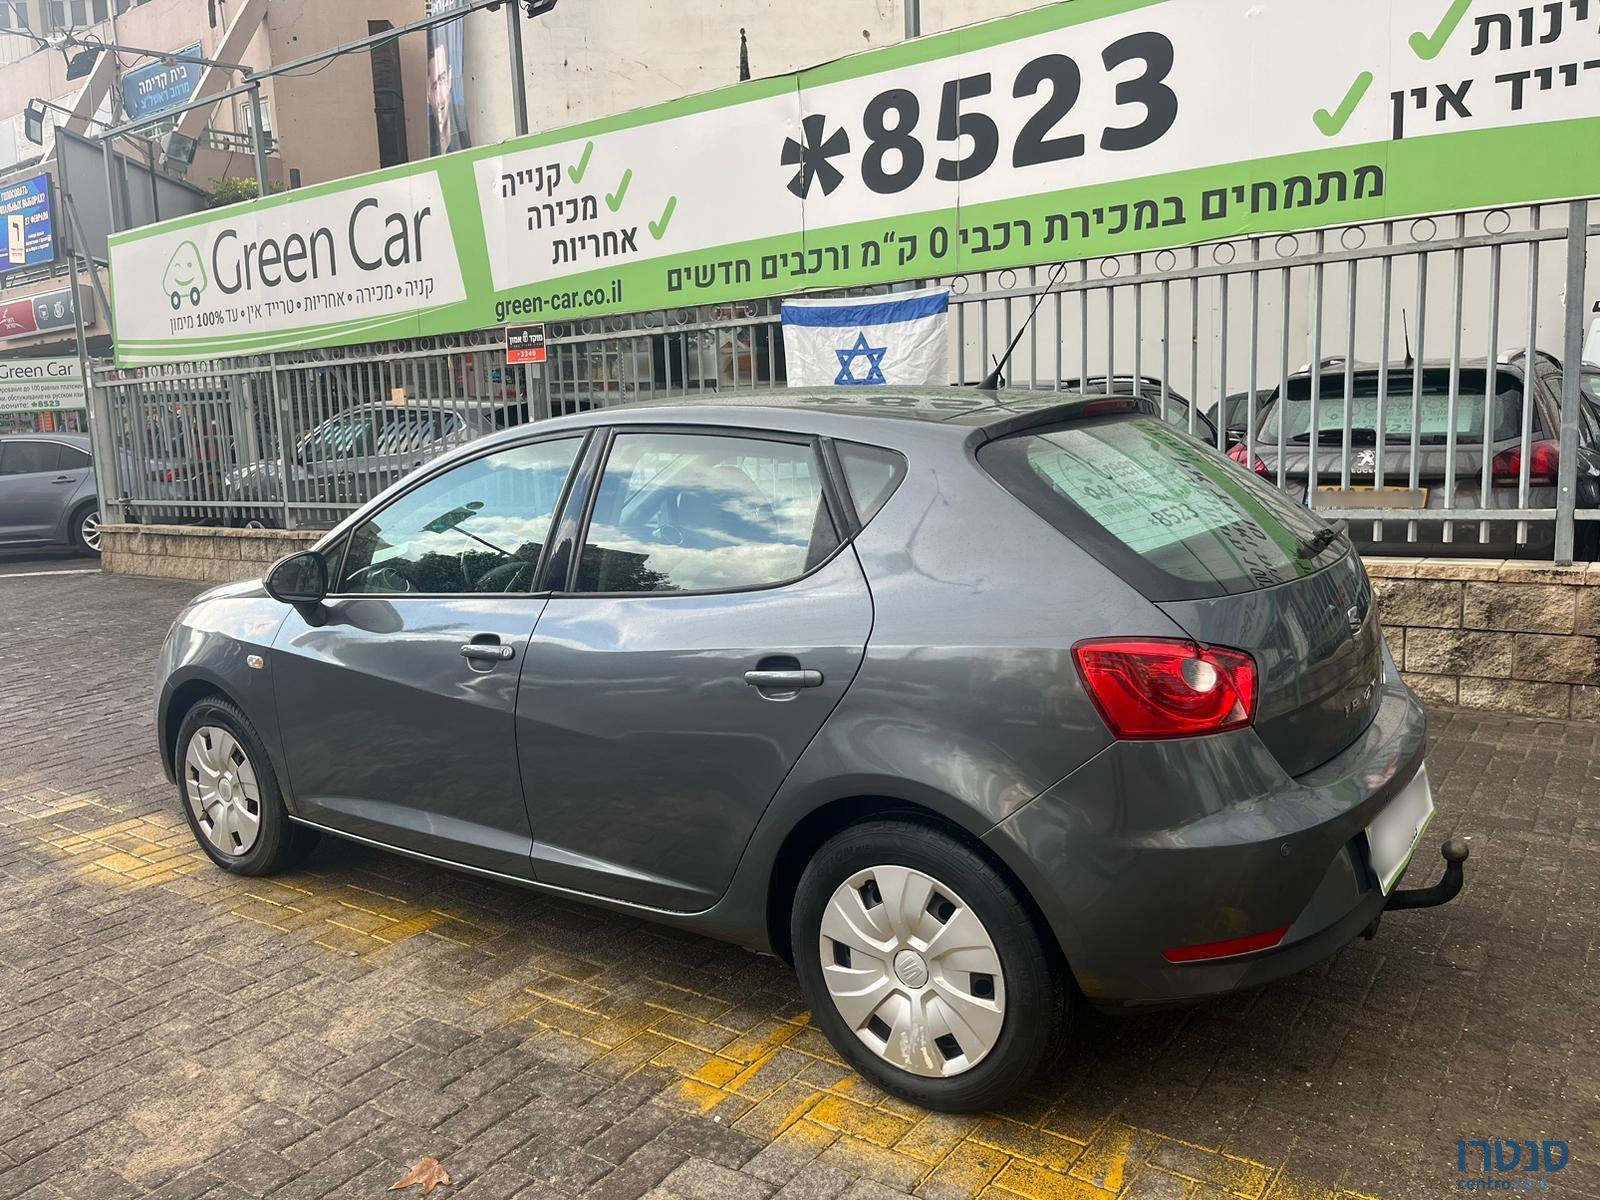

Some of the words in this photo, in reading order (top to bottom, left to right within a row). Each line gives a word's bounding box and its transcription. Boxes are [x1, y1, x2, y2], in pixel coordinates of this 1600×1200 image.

[1471, 0, 1600, 55] ינות
[139, 72, 168, 94] קדימה
[170, 66, 188, 83] בית
[1391, 79, 1474, 140] אין
[501, 163, 561, 198] קנייה
[1201, 164, 1385, 222] מתמחים
[527, 194, 598, 230] מכירה
[1042, 195, 1186, 244] במכירת
[212, 228, 337, 295] Green
[348, 197, 431, 272] Car
[552, 227, 638, 265] אחריות
[929, 226, 948, 259] 0
[959, 218, 1032, 254] רכבי
[667, 259, 751, 292] חדשים
[761, 244, 849, 280] ורכבים
[304, 291, 345, 311] אחריות
[356, 284, 393, 304] מכירה
[405, 278, 434, 299] קניה
[495, 279, 622, 322] green-car.co.il
[196, 311, 225, 327] 100%
[225, 308, 239, 322] עד
[246, 304, 262, 324] אין
[265, 299, 294, 316] טרייד
[169, 315, 194, 335] מימון
[47, 361, 73, 376] Car
